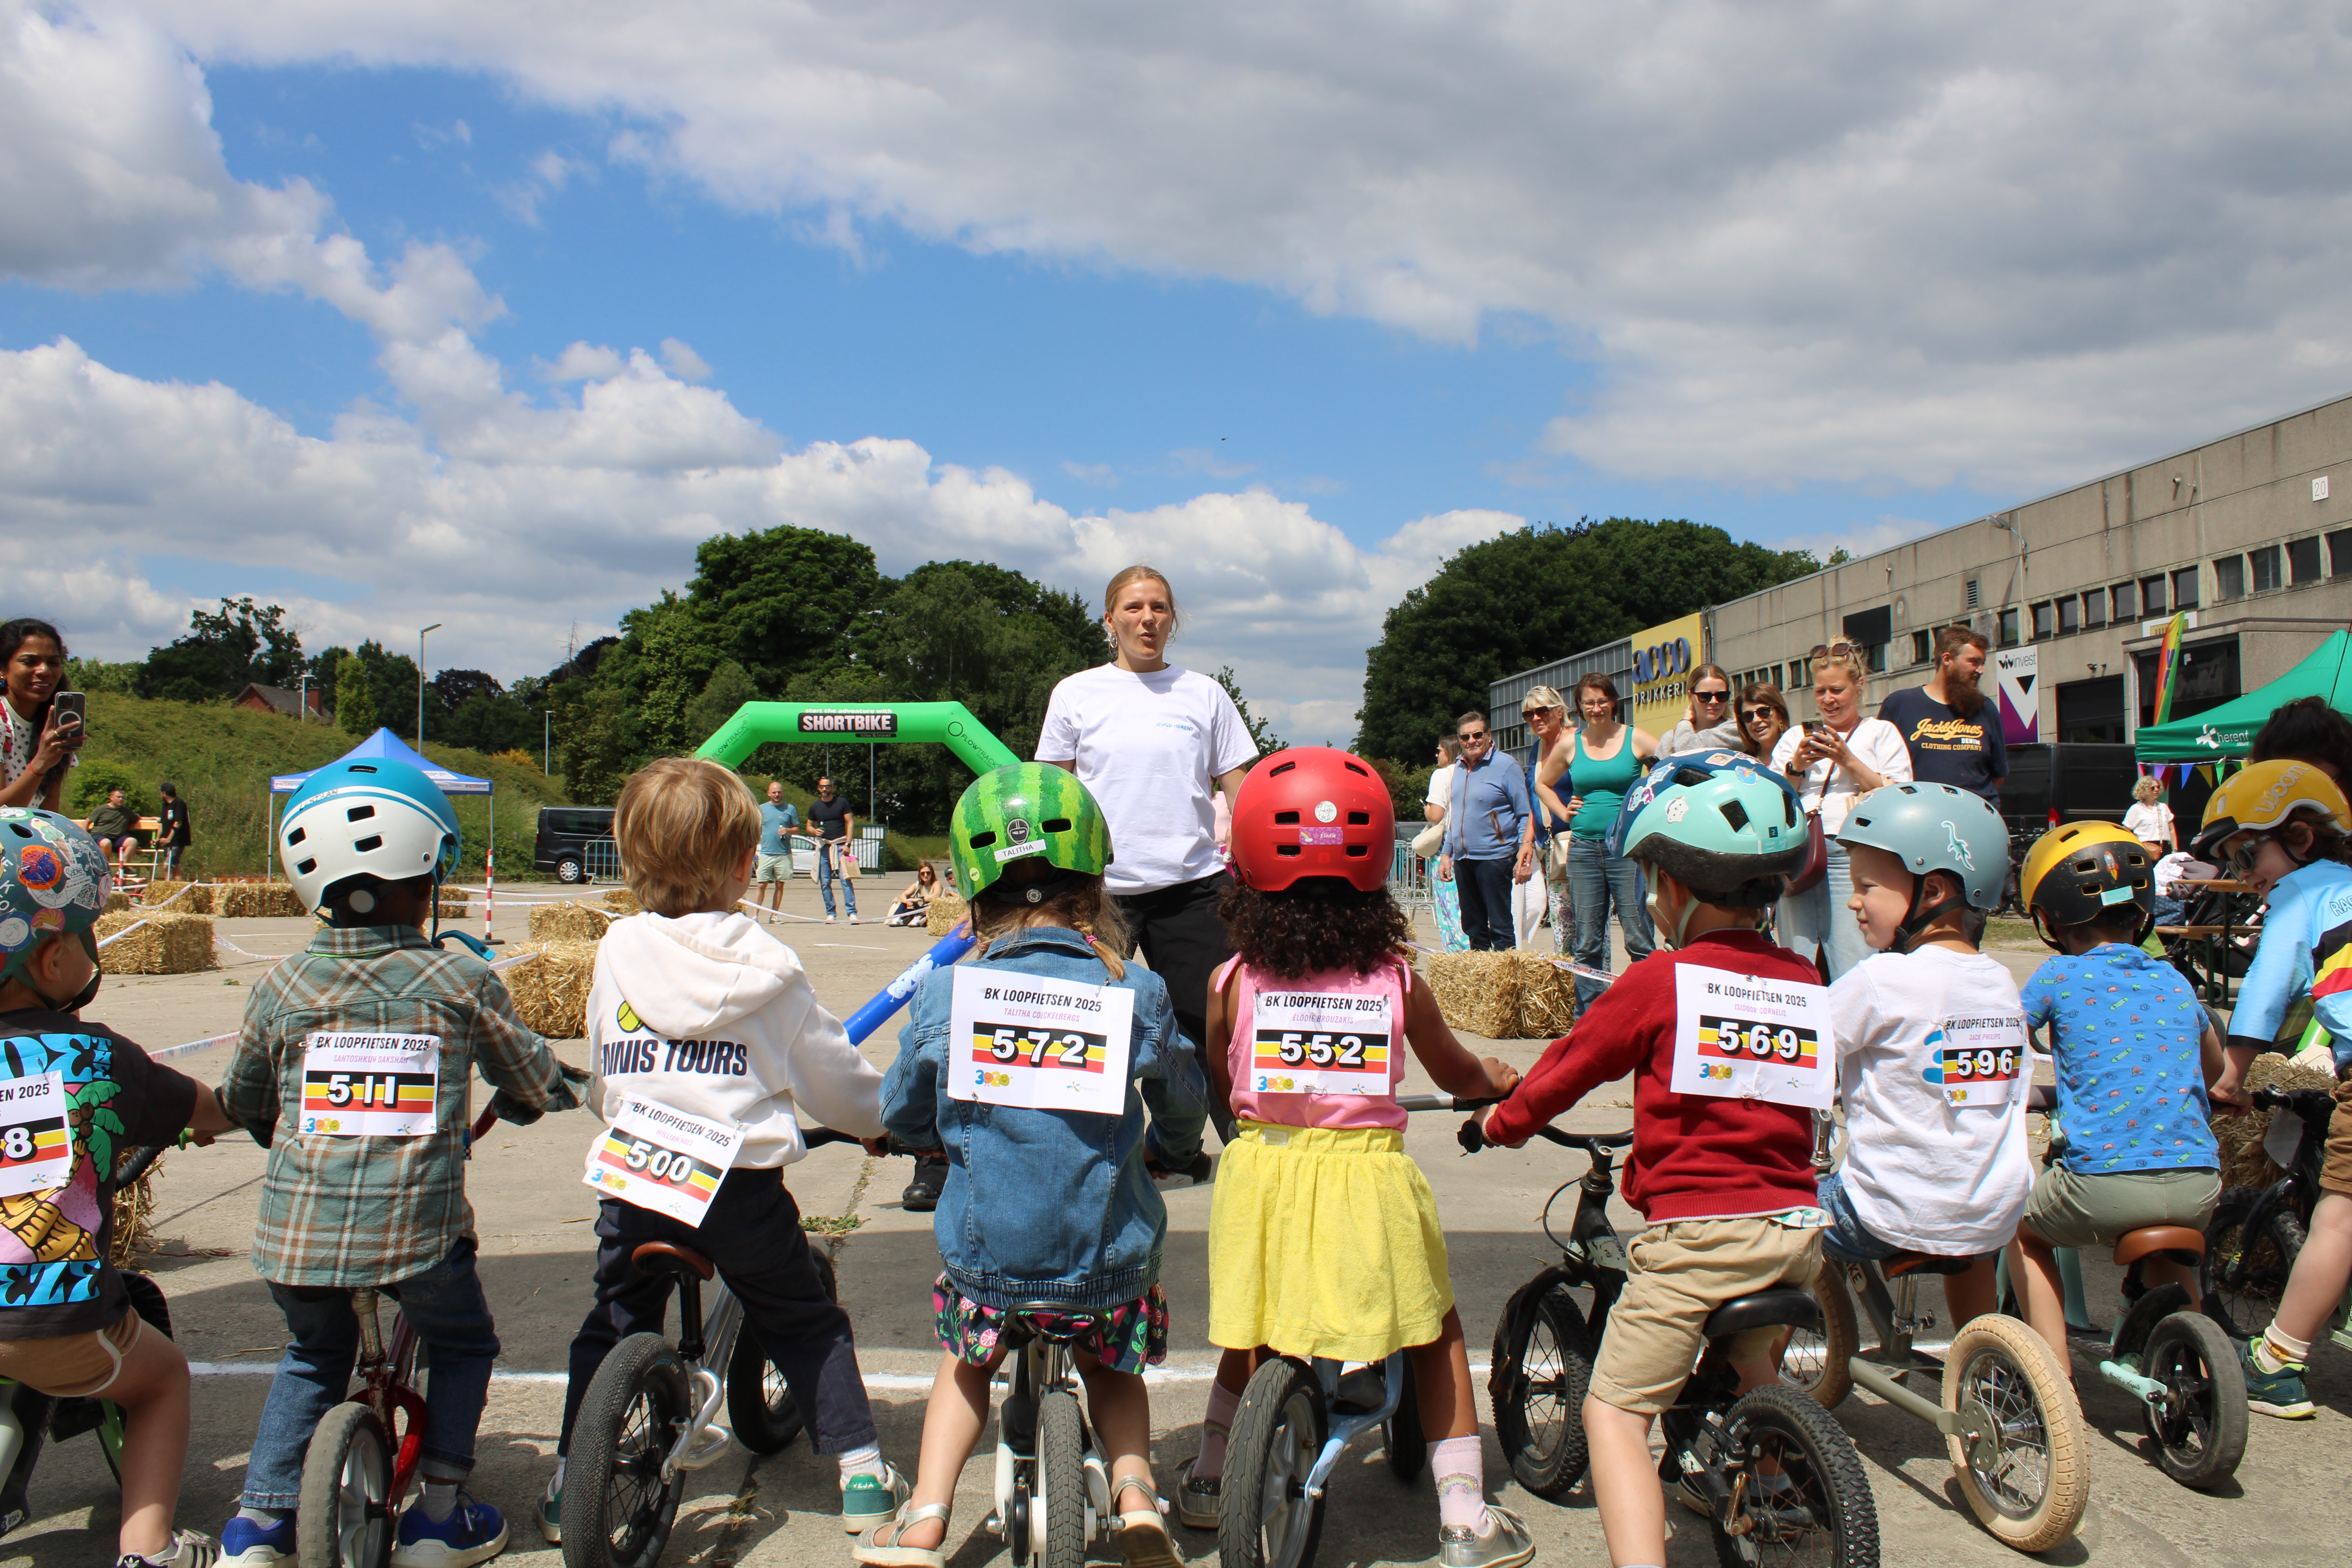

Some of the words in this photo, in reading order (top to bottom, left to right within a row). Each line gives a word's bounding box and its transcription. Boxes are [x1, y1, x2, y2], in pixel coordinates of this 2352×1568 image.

[1632, 637, 1690, 684] acco
[1634, 681, 1687, 705] DRUKKERI
[803, 715, 891, 731] SHORTBIKE
[1953, 743, 1982, 751] COMPANY
[2217, 730, 2249, 743] herent
[2254, 766, 2310, 813] woom
[1002, 844, 1034, 858] TALITHA
[984, 988, 1000, 1000] BK
[1003, 989, 1072, 1007] LOOPFIETSEN
[1075, 997, 1102, 1012] 2025
[1266, 996, 1281, 1007] BK
[1283, 996, 1352, 1010] LOOPFIETSEN
[1356, 1000, 1382, 1011] 2025
[1708, 983, 1720, 995] BK
[1724, 985, 1782, 1004] LOOPFIETSEN
[1786, 995, 1806, 1007] 2025
[1004, 1008, 1031, 1018] TALITHA
[1032, 1011, 1080, 1022] COECKELBERGS
[1292, 1013, 1315, 1022] ÉLODIE
[1317, 1015, 1354, 1024] BROUZAKIS
[1734, 1004, 1757, 1014] ISIDOOR
[1759, 1007, 1786, 1017] CORNELIS
[1957, 1018, 2004, 1029] LOOPFIETSEN
[316, 1036, 332, 1048] BK
[334, 1037, 400, 1049] LOOPFIETSEN
[402, 1039, 430, 1051] 2025
[991, 1029, 1087, 1069] 572
[1278, 1033, 1365, 1069] 552
[1717, 1021, 1801, 1064] 569
[664, 1039, 748, 1076] TOURS
[1956, 1049, 2015, 1080] 596
[18, 1083, 50, 1099] 2025
[326, 1074, 398, 1108] 511
[633, 1102, 648, 1115] BK
[648, 1107, 707, 1136] LOOPFIETSEN
[707, 1129, 732, 1147] 2025
[656, 1129, 681, 1143] WILLIAM
[624, 1140, 693, 1186] 500
